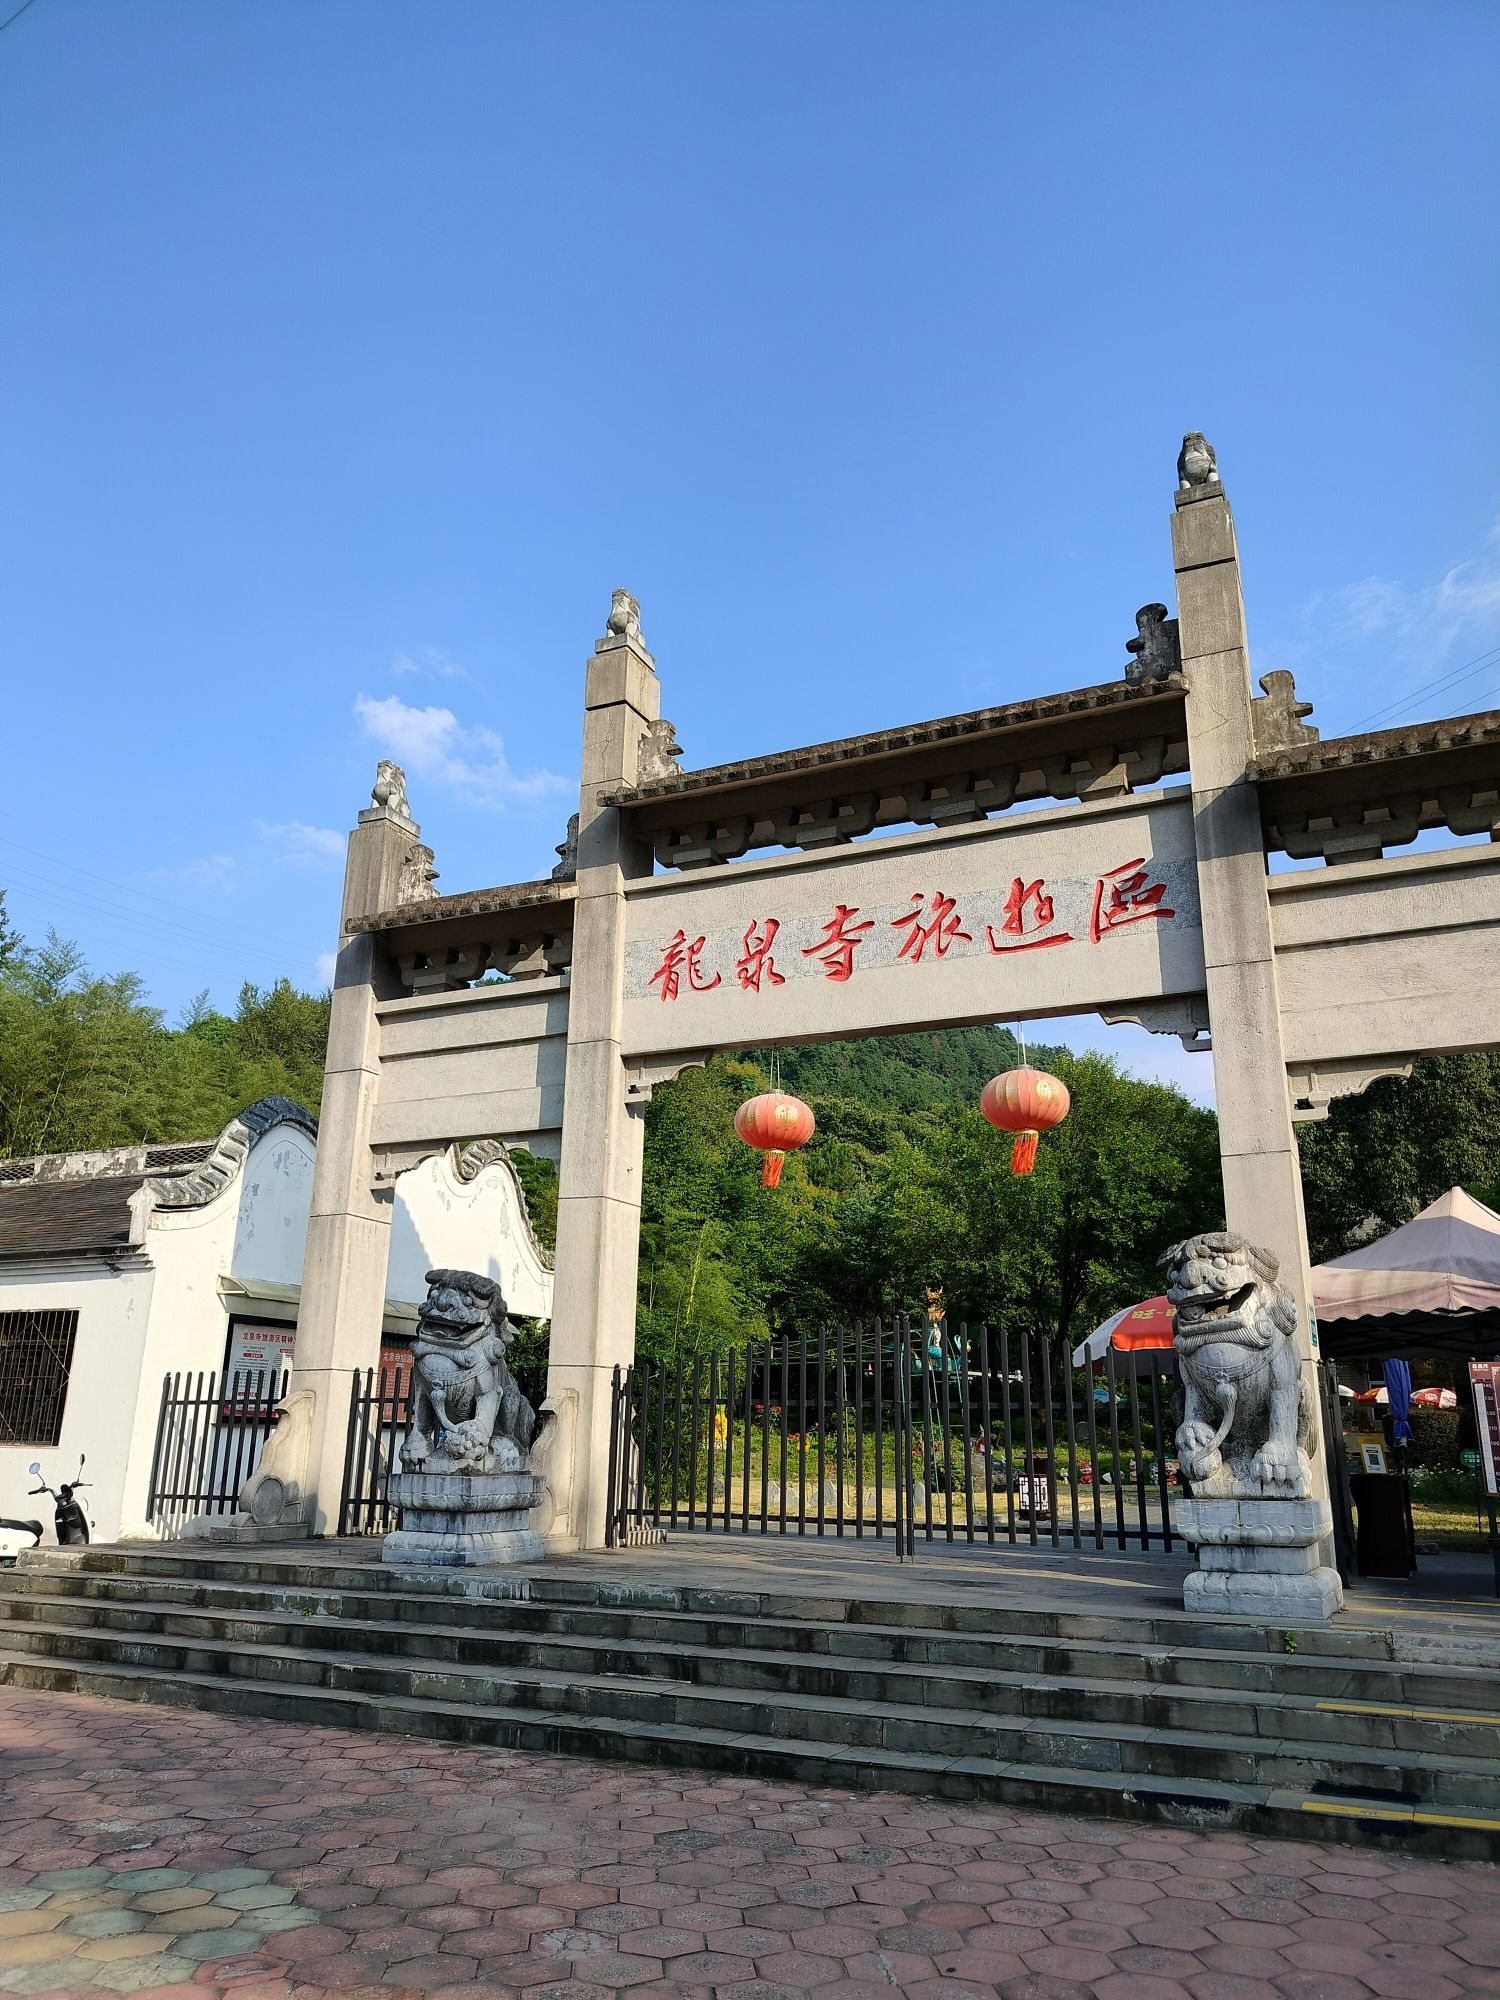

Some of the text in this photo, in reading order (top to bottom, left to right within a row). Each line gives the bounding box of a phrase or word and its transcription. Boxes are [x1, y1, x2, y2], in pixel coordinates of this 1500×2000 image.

[648, 857, 1176, 1002] 龍泉寺旅遊區
[242, 1332, 296, 1345] 龙泉寺旅游区精神
